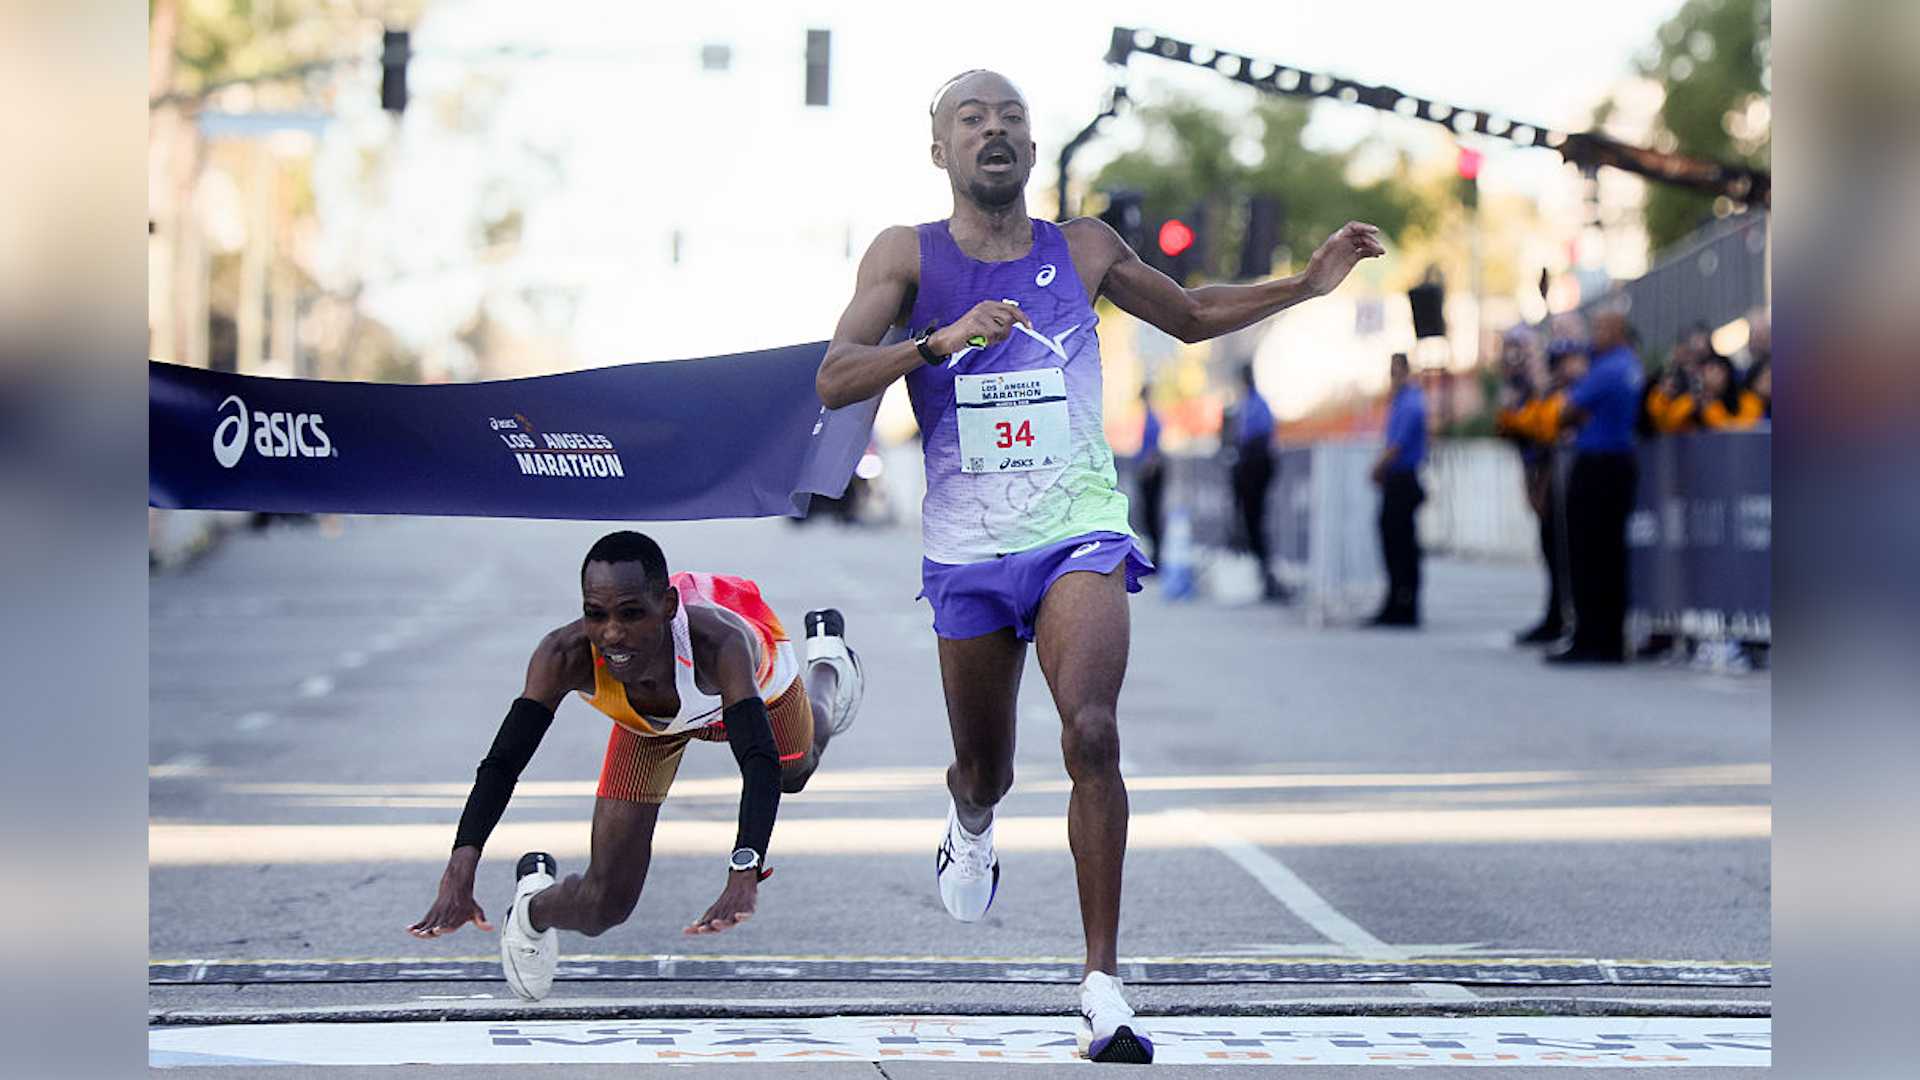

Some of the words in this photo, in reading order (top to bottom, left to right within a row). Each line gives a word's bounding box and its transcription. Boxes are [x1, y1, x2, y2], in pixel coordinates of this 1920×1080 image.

[982, 389, 1042, 400] MARATHON
[500, 433, 536, 449] LOS
[542, 433, 613, 449] ANGELES
[995, 419, 1035, 449] 34
[514, 453, 625, 477] MARATHON
